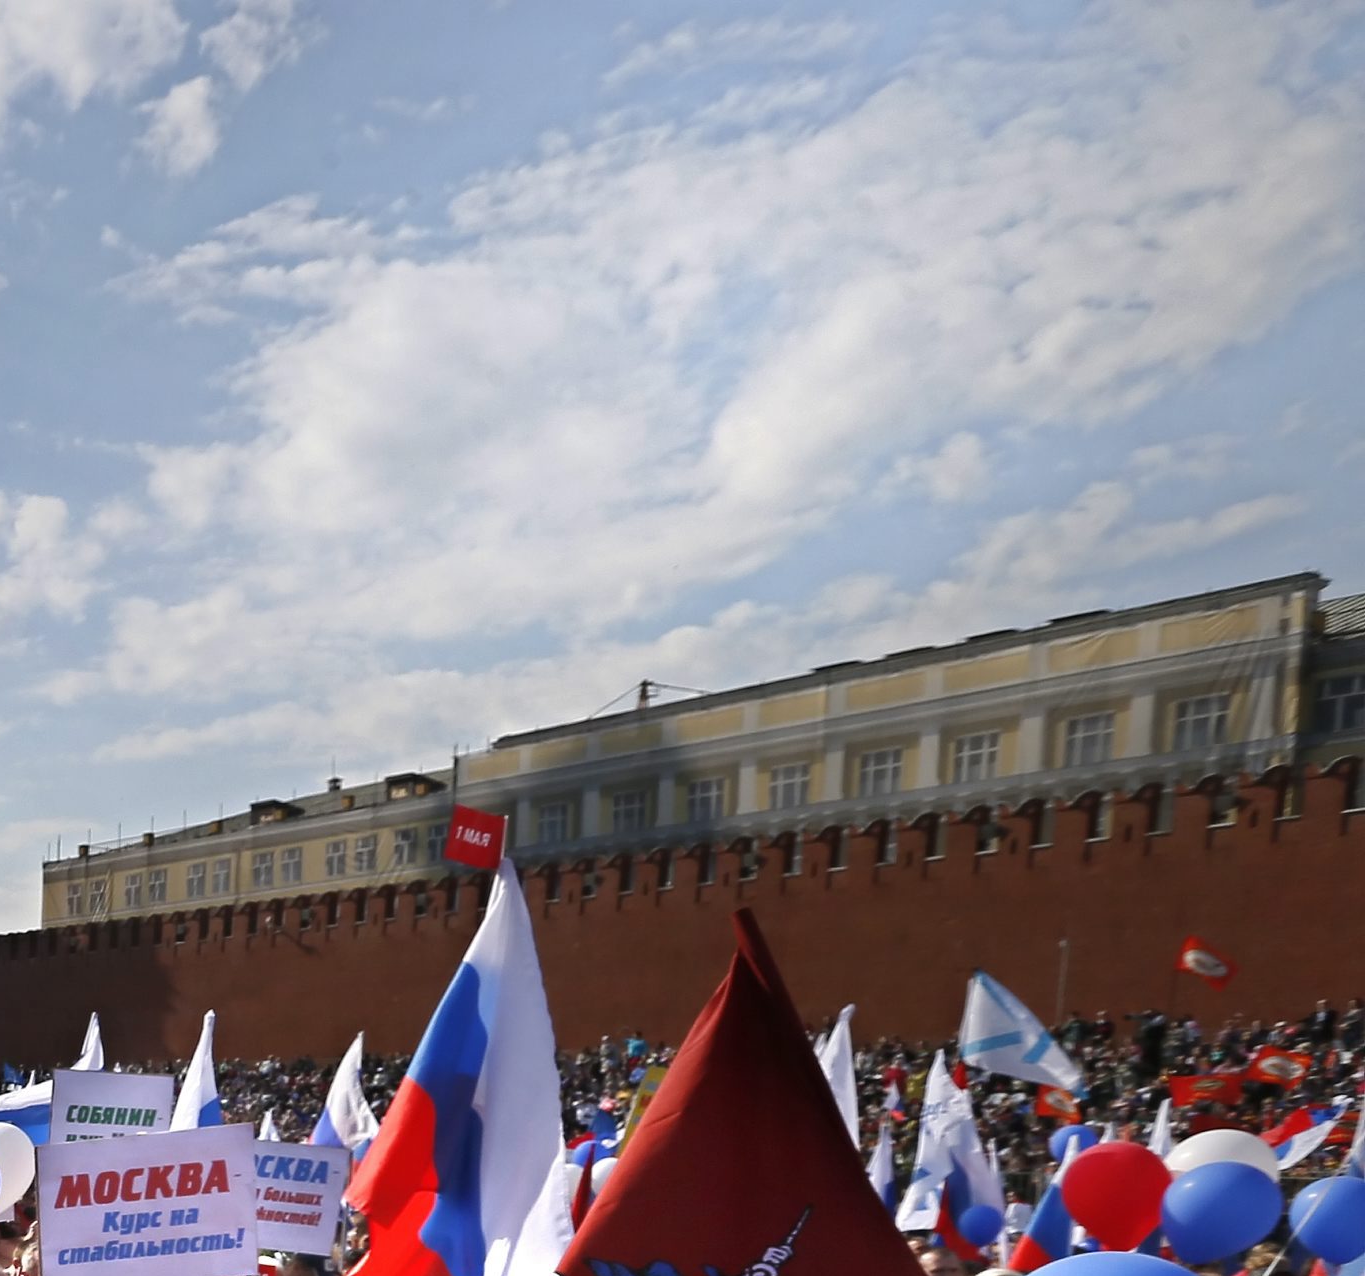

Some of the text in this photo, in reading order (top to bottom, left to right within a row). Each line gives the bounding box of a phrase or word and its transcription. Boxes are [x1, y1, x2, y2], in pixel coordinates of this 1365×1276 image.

[464, 827, 492, 848] МАЯ
[54, 1159, 230, 1209] МОСКВА
[264, 1187, 323, 1206] больших
[102, 1208, 199, 1235] Курс на
[58, 1228, 246, 1266] стабильность!
